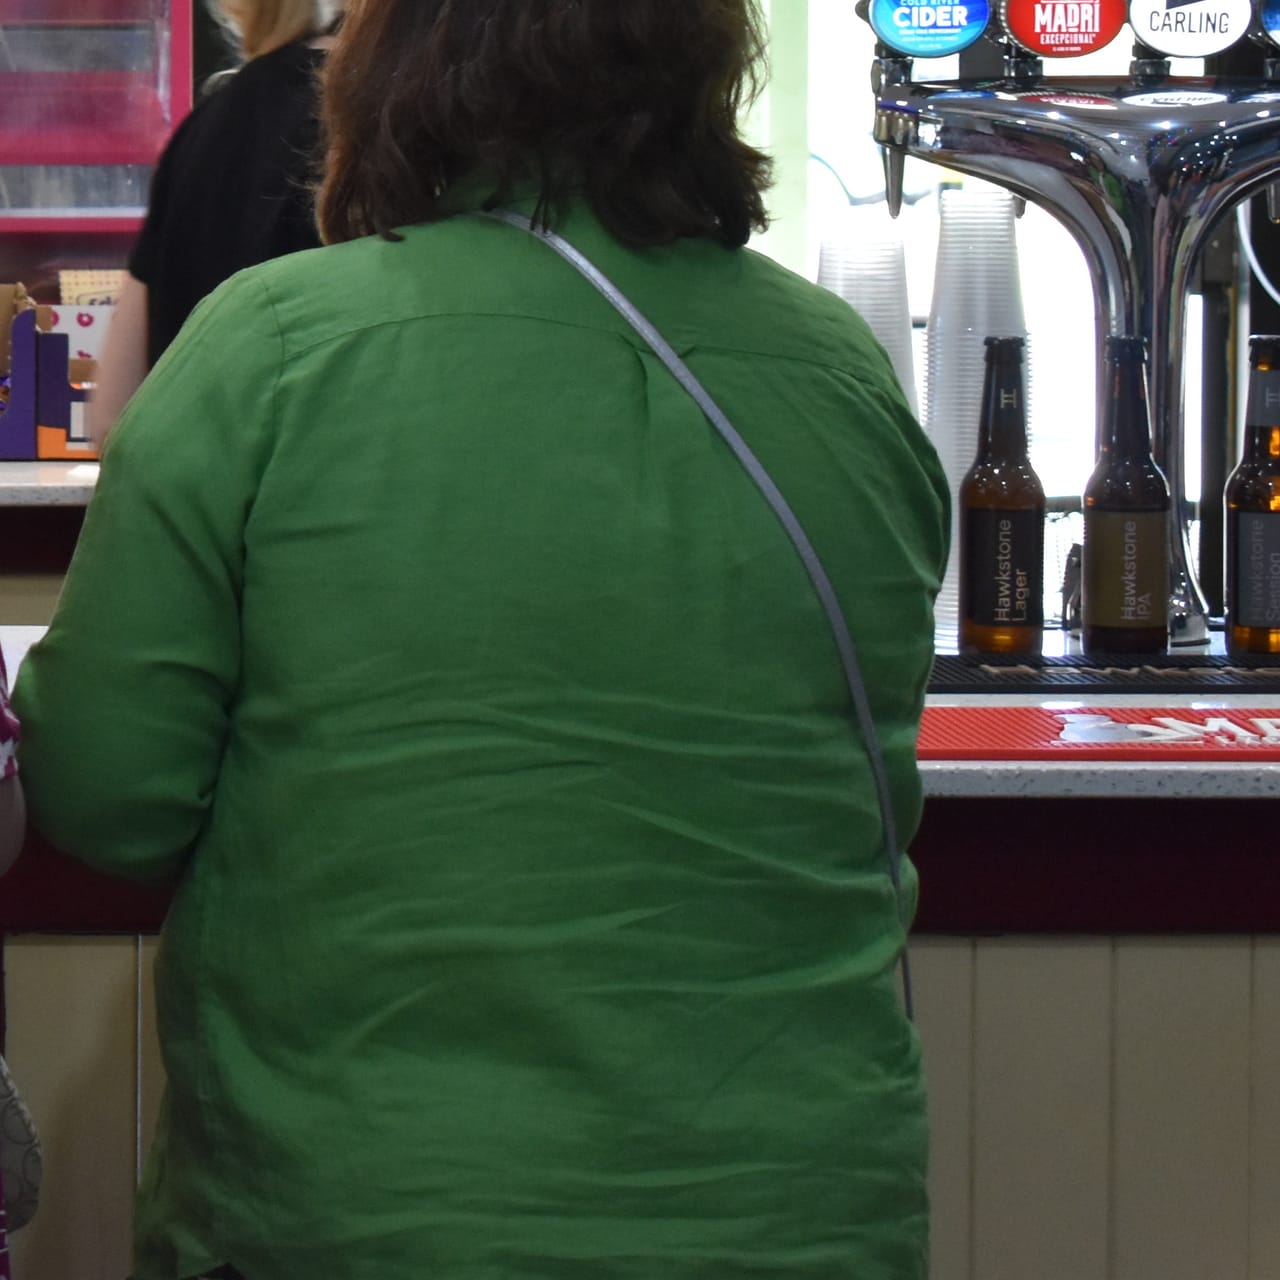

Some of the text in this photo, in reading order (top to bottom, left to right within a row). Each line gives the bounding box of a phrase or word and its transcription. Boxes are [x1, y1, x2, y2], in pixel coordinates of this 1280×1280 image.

[893, 6, 968, 27] CIDER
[1034, 0, 1100, 33] MADRÍ
[1149, 11, 1229, 34] CARLING
[994, 519, 1012, 622] Hawkstone
[1121, 521, 1137, 620] Hawkstone
[1012, 568, 1028, 622] Lager
[1136, 592, 1152, 620] IPA
